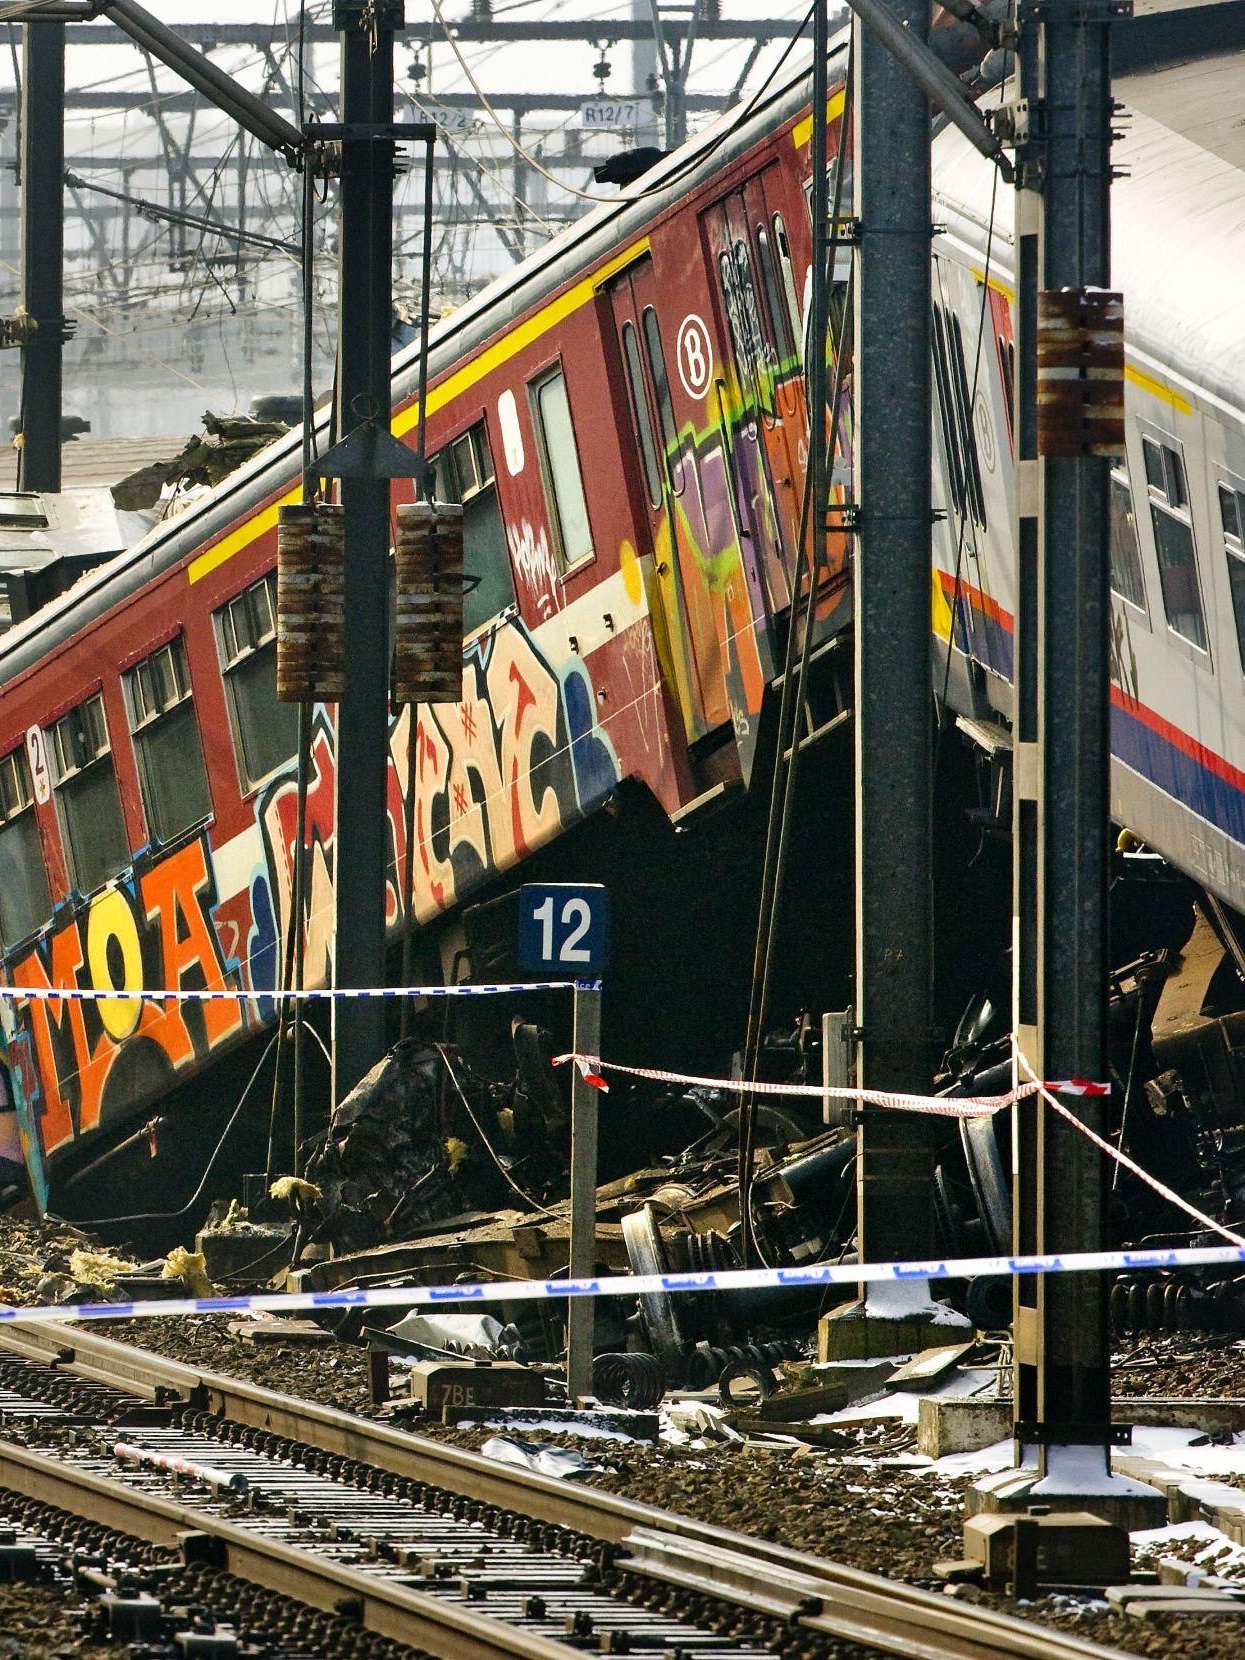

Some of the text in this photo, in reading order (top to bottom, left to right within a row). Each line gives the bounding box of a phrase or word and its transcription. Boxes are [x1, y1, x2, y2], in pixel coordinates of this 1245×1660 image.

[585, 105, 634, 125] R12/7
[31, 732, 45, 776] 2
[533, 897, 591, 962] 12
[12, 837, 243, 1157] MOA
